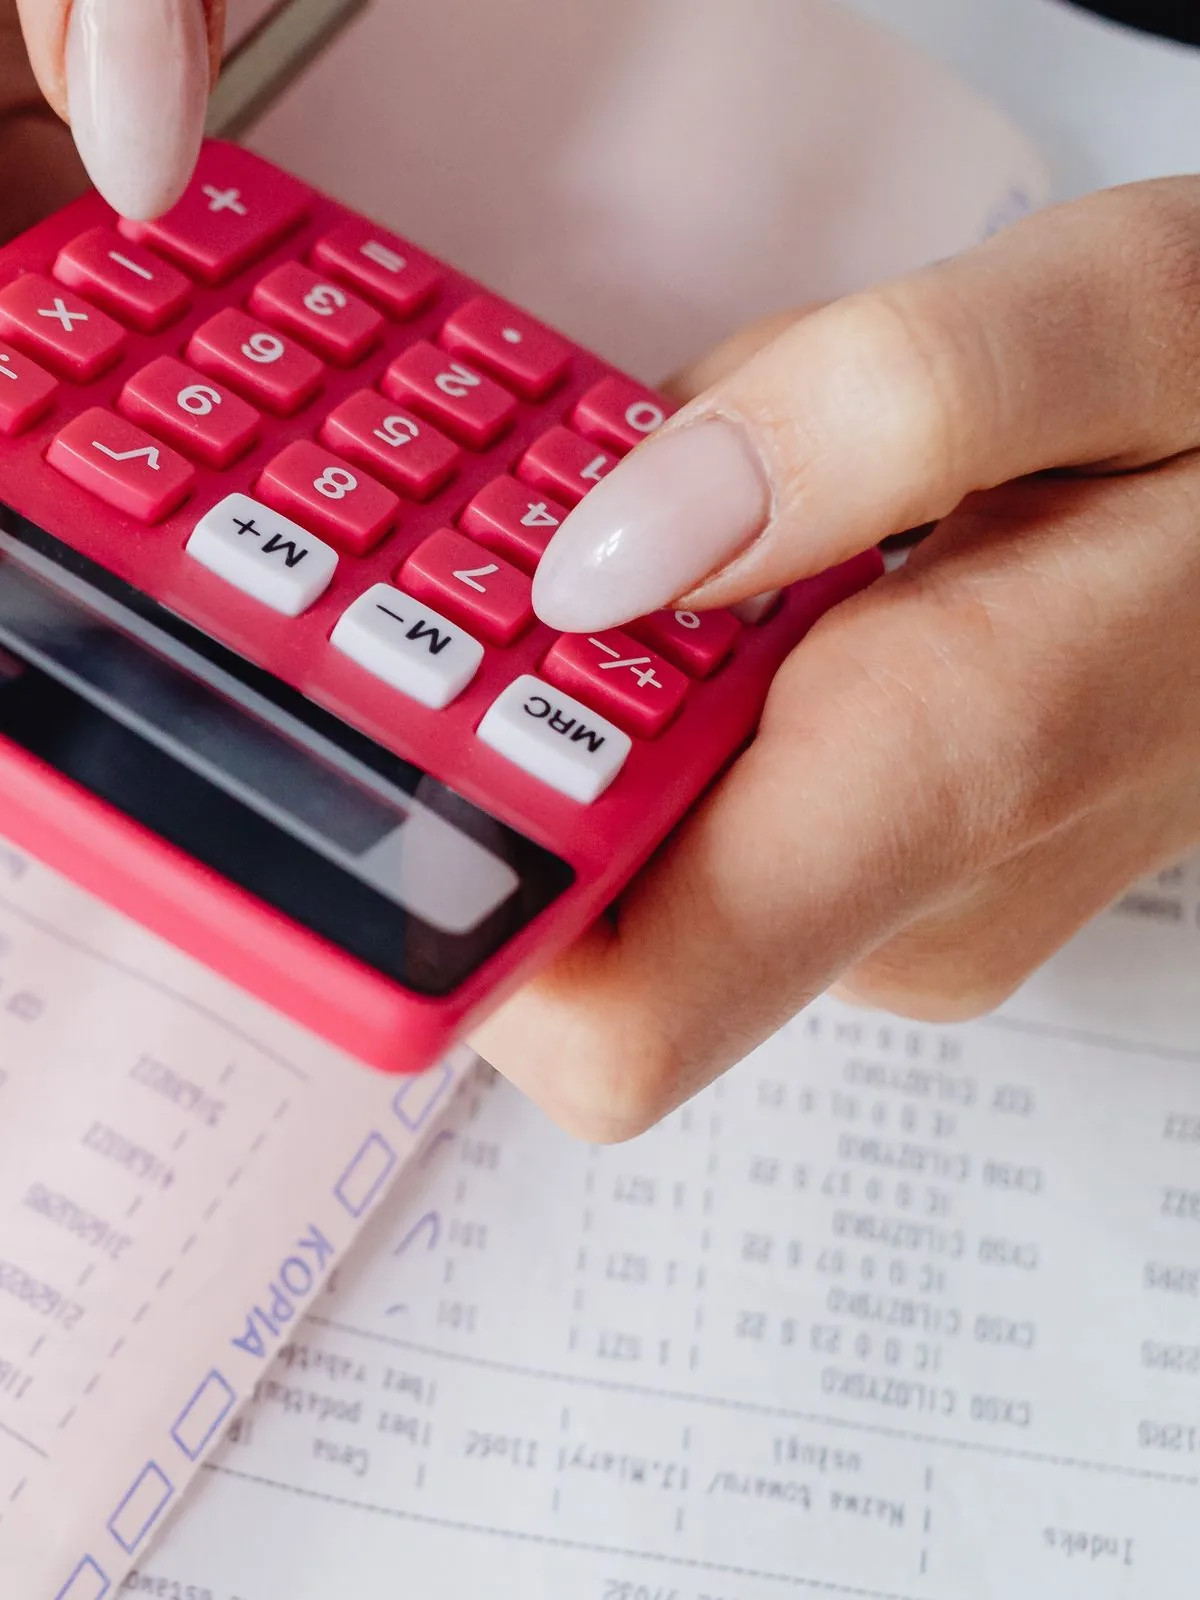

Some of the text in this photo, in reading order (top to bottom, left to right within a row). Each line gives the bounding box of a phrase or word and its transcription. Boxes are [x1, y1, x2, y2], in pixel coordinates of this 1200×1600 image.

[303, 283, 346, 317] 3
[241, 333, 285, 362] 6
[435, 365, 481, 397] 2
[177, 385, 221, 417] 9
[373, 415, 419, 447] 5
[313, 466, 358, 499] 8
[520, 502, 560, 526] 4
[232, 518, 308, 568] M+
[452, 563, 500, 593] 7
[523, 696, 605, 753] MRC
[231, 1223, 335, 1358] KOPIA
[826, 1488, 906, 1529] Nazwa
[1038, 1522, 1137, 1567] Indeks
